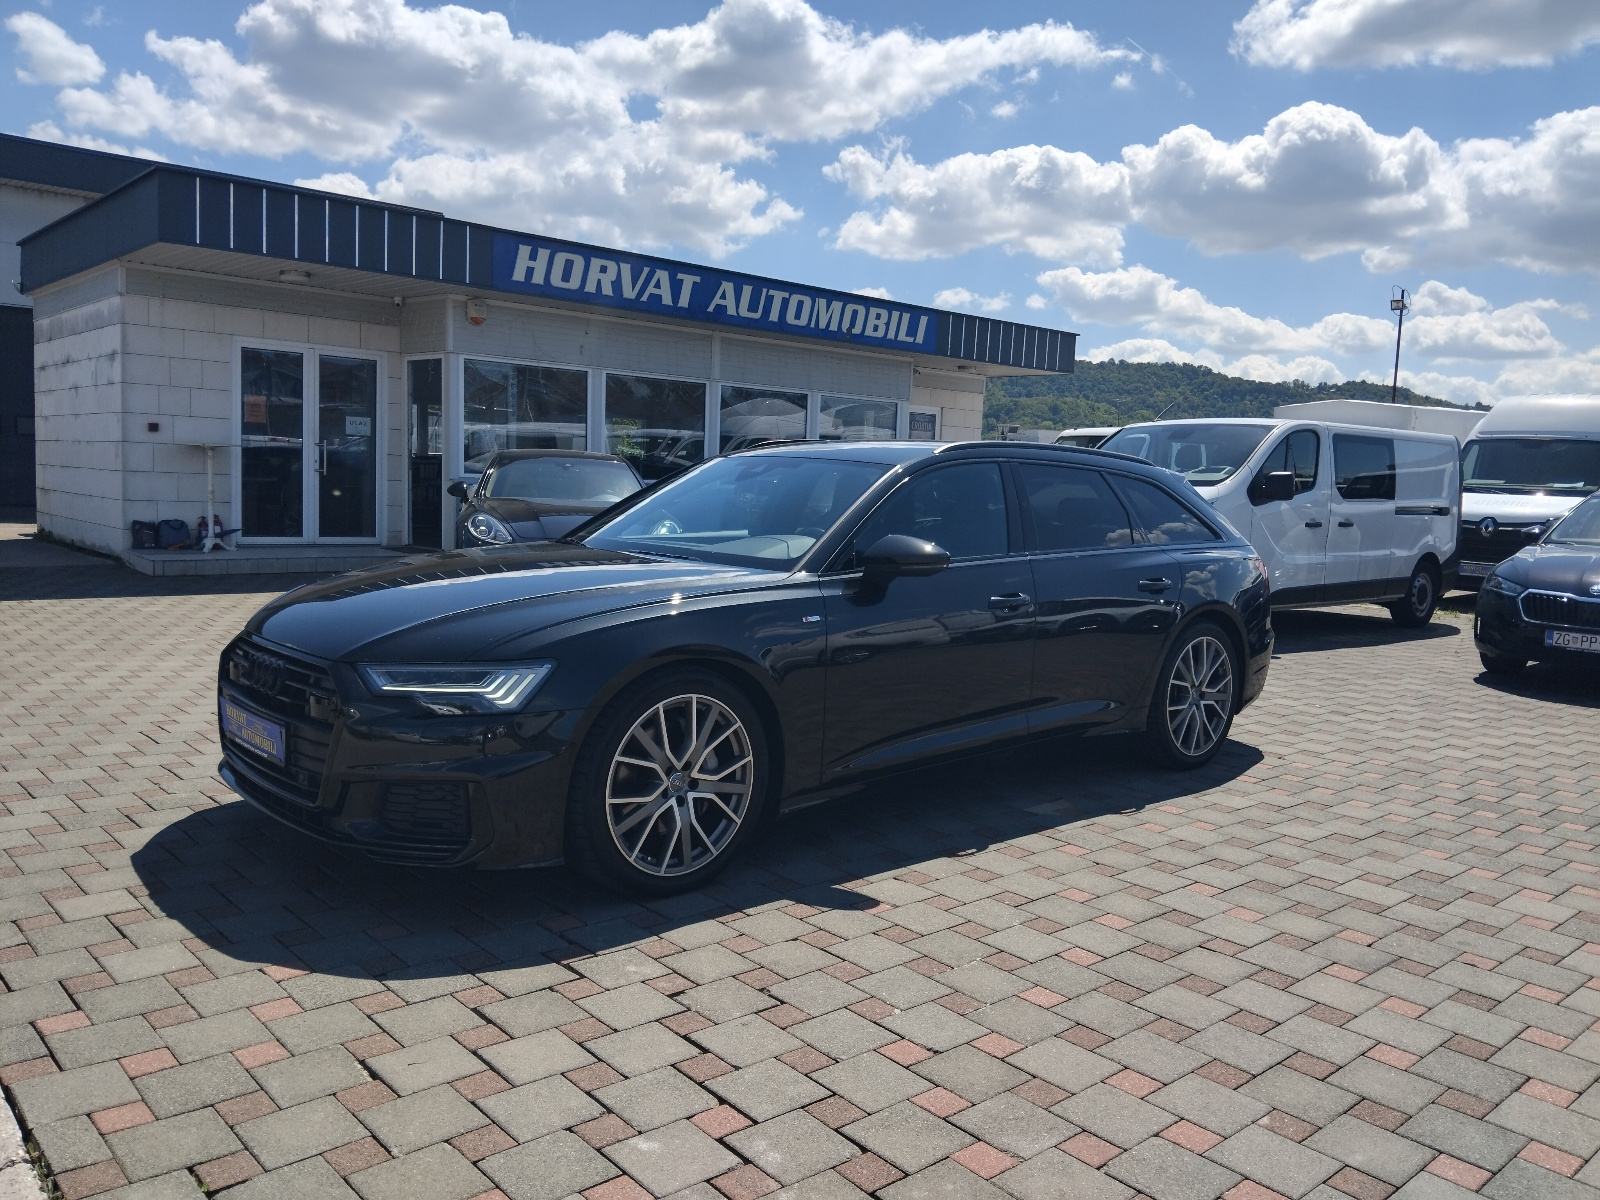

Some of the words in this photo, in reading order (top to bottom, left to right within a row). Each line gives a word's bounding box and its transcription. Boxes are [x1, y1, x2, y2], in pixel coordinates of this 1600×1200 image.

[512, 244, 700, 308] HORVAT
[707, 280, 928, 345] AUTOMOBILI
[1554, 632, 1570, 646] ZG
